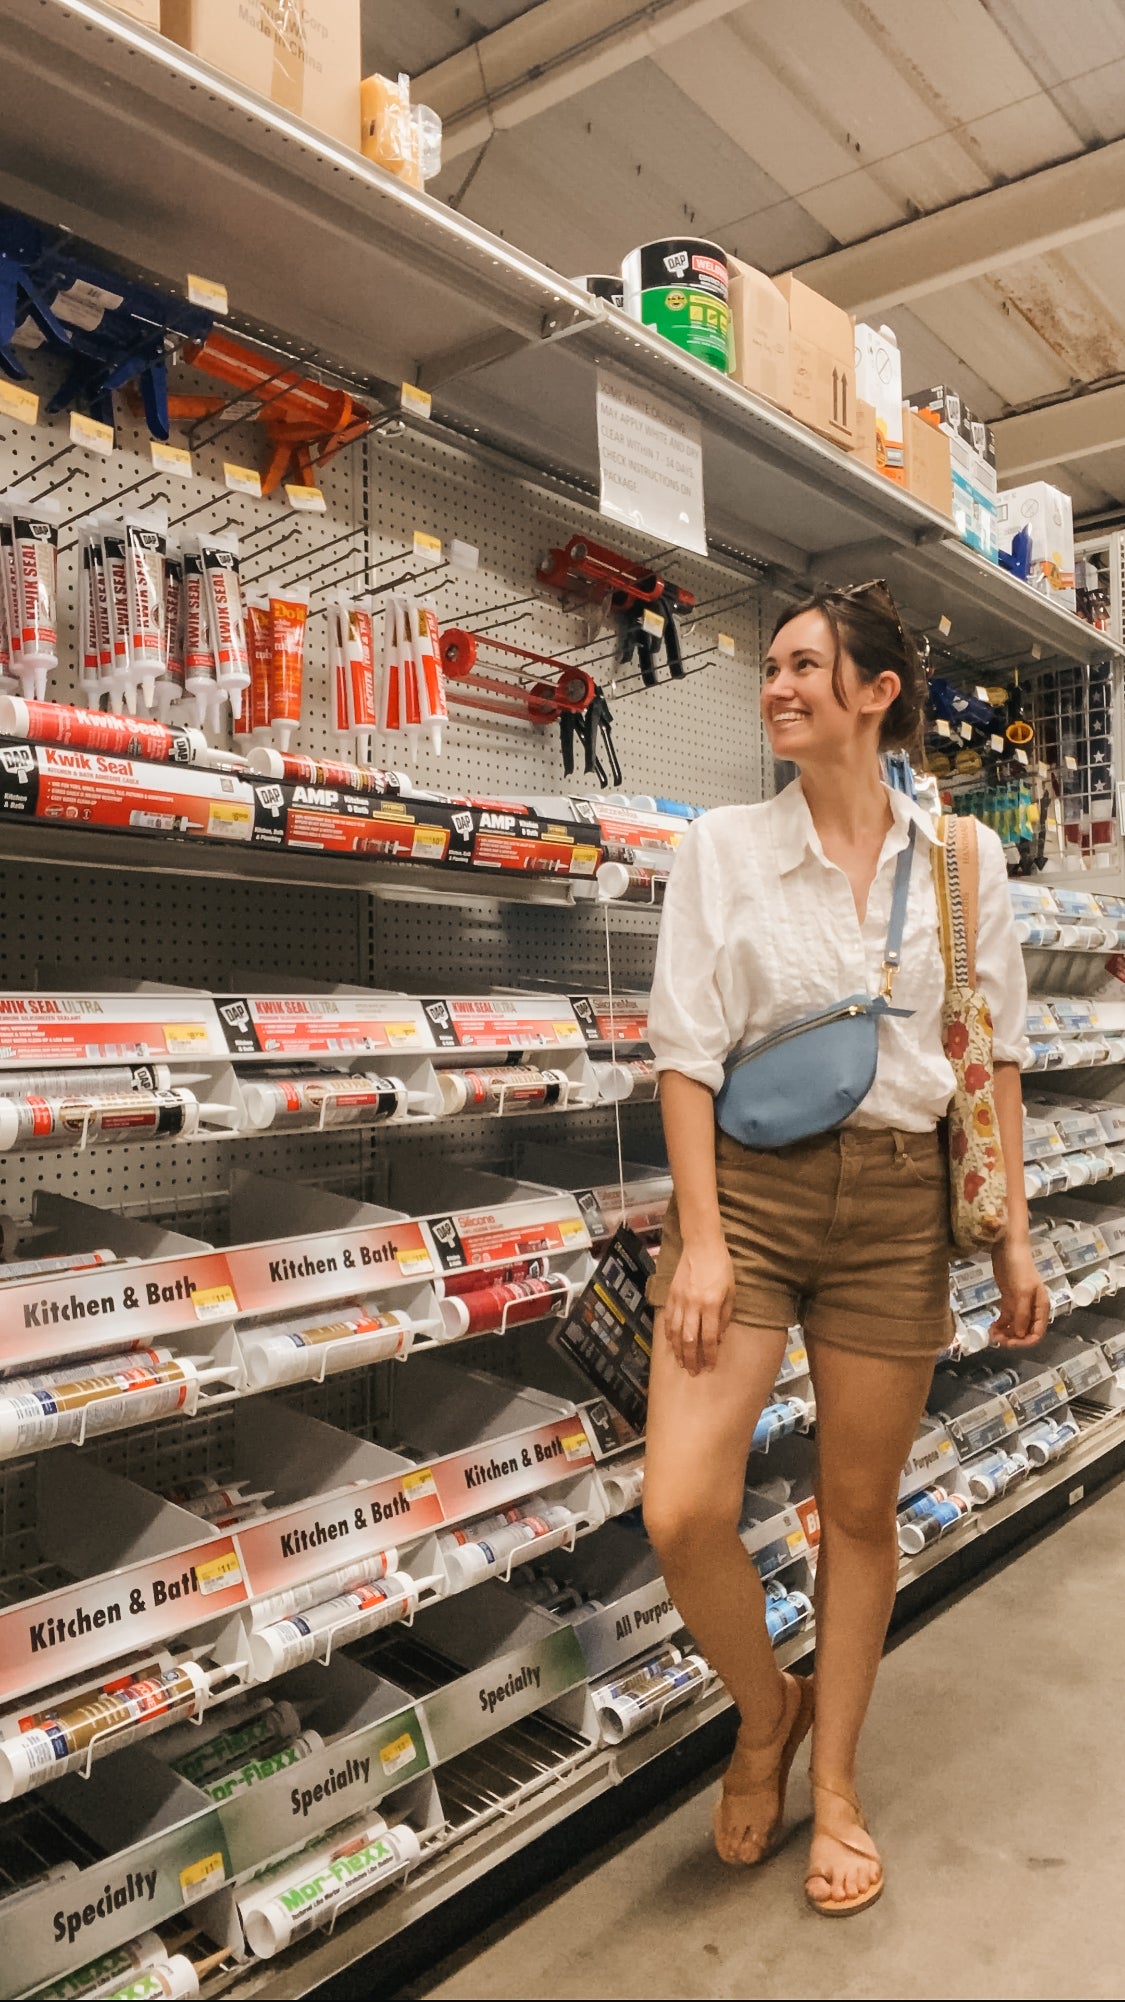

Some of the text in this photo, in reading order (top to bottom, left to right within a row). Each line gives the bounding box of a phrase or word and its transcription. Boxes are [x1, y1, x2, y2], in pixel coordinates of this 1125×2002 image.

[239, 4, 271, 38] Made
[289, 41, 323, 74] China
[667, 254, 686, 269] DAP
[600, 402, 618, 421] MAY
[620, 412, 643, 432] APPLY
[645, 424, 668, 446] WHITE
[669, 436, 685, 454] AND
[601, 425, 625, 442] CLEAR
[627, 439, 654, 460] WITHIN
[601, 446, 692, 497] CHECK INSTRUCTIONS ON
[33, 525, 48, 536] DAP
[142, 534, 159, 546] DAP
[219, 553, 233, 565] DAP
[21, 544, 40, 620] KWIK SEAL
[112, 563, 130, 636] KWIK SEAL
[187, 577, 201, 649] KWIK SEAL
[211, 572, 233, 644] KWIK SEAL
[365, 671, 375, 714] LOCTITE
[74, 708, 168, 739] Kwik Seal
[4, 749, 30, 768] DAP
[44, 748, 134, 778] Kwik Seal
[176, 739, 189, 762] DAP
[260, 788, 281, 804] DAP
[291, 786, 339, 807] AMP
[455, 817, 471, 831] DAP
[479, 812, 516, 831] AMP
[0, 1000, 104, 1014] WIK SEAL ULTRA
[224, 1006, 245, 1021] DAP
[254, 1000, 285, 1014] KWIK
[284, 1000, 310, 1014] SEAL
[308, 1000, 340, 1014] ULTRA
[430, 1006, 445, 1020] DAP
[451, 1001, 518, 1014] KWIK SEAL ULTRA
[137, 1070, 151, 1089] DAP
[437, 1224, 452, 1238] DAP
[457, 1213, 497, 1229] Silicone
[269, 1255, 338, 1282] Kitchen
[342, 1249, 357, 1268] &
[23, 1276, 197, 1328] Kitchen & Bath
[464, 1437, 564, 1489] Kitchen & Bath
[912, 1449, 940, 1471] Purpose
[279, 1491, 411, 1558] Kitchen & Bath
[29, 1602, 122, 1652] Kitchen
[129, 1588, 146, 1614] &
[615, 1597, 673, 1642] All Purpos
[478, 1664, 541, 1713] Specialty
[291, 1755, 371, 1816] Specialty
[280, 1841, 391, 1912] Mor-Flexx
[53, 1869, 158, 1943] Specialty
